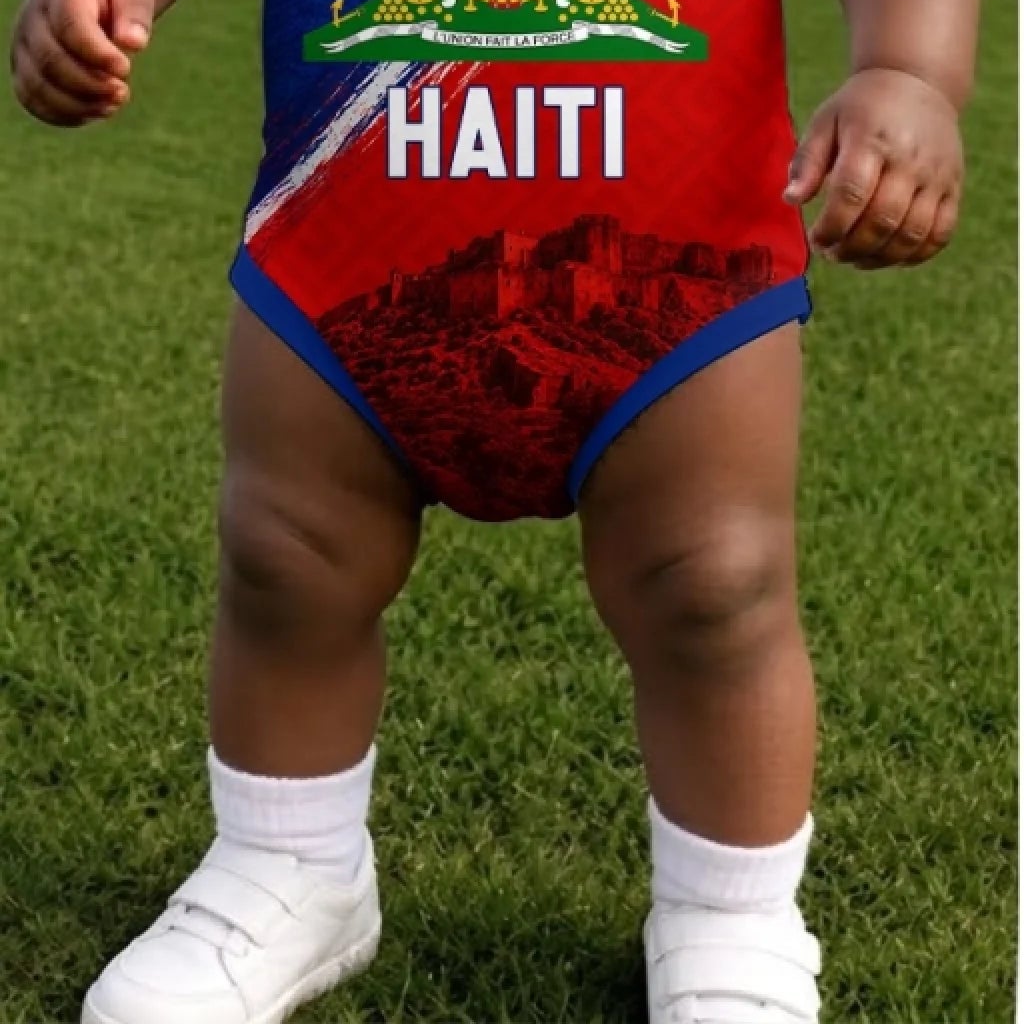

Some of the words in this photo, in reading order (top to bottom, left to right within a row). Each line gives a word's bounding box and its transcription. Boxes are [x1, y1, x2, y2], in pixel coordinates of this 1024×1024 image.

[486, 36, 511, 46] FAIT
[515, 36, 531, 46] LA
[534, 31, 573, 45] FORCE
[386, 86, 625, 179] HAITI
